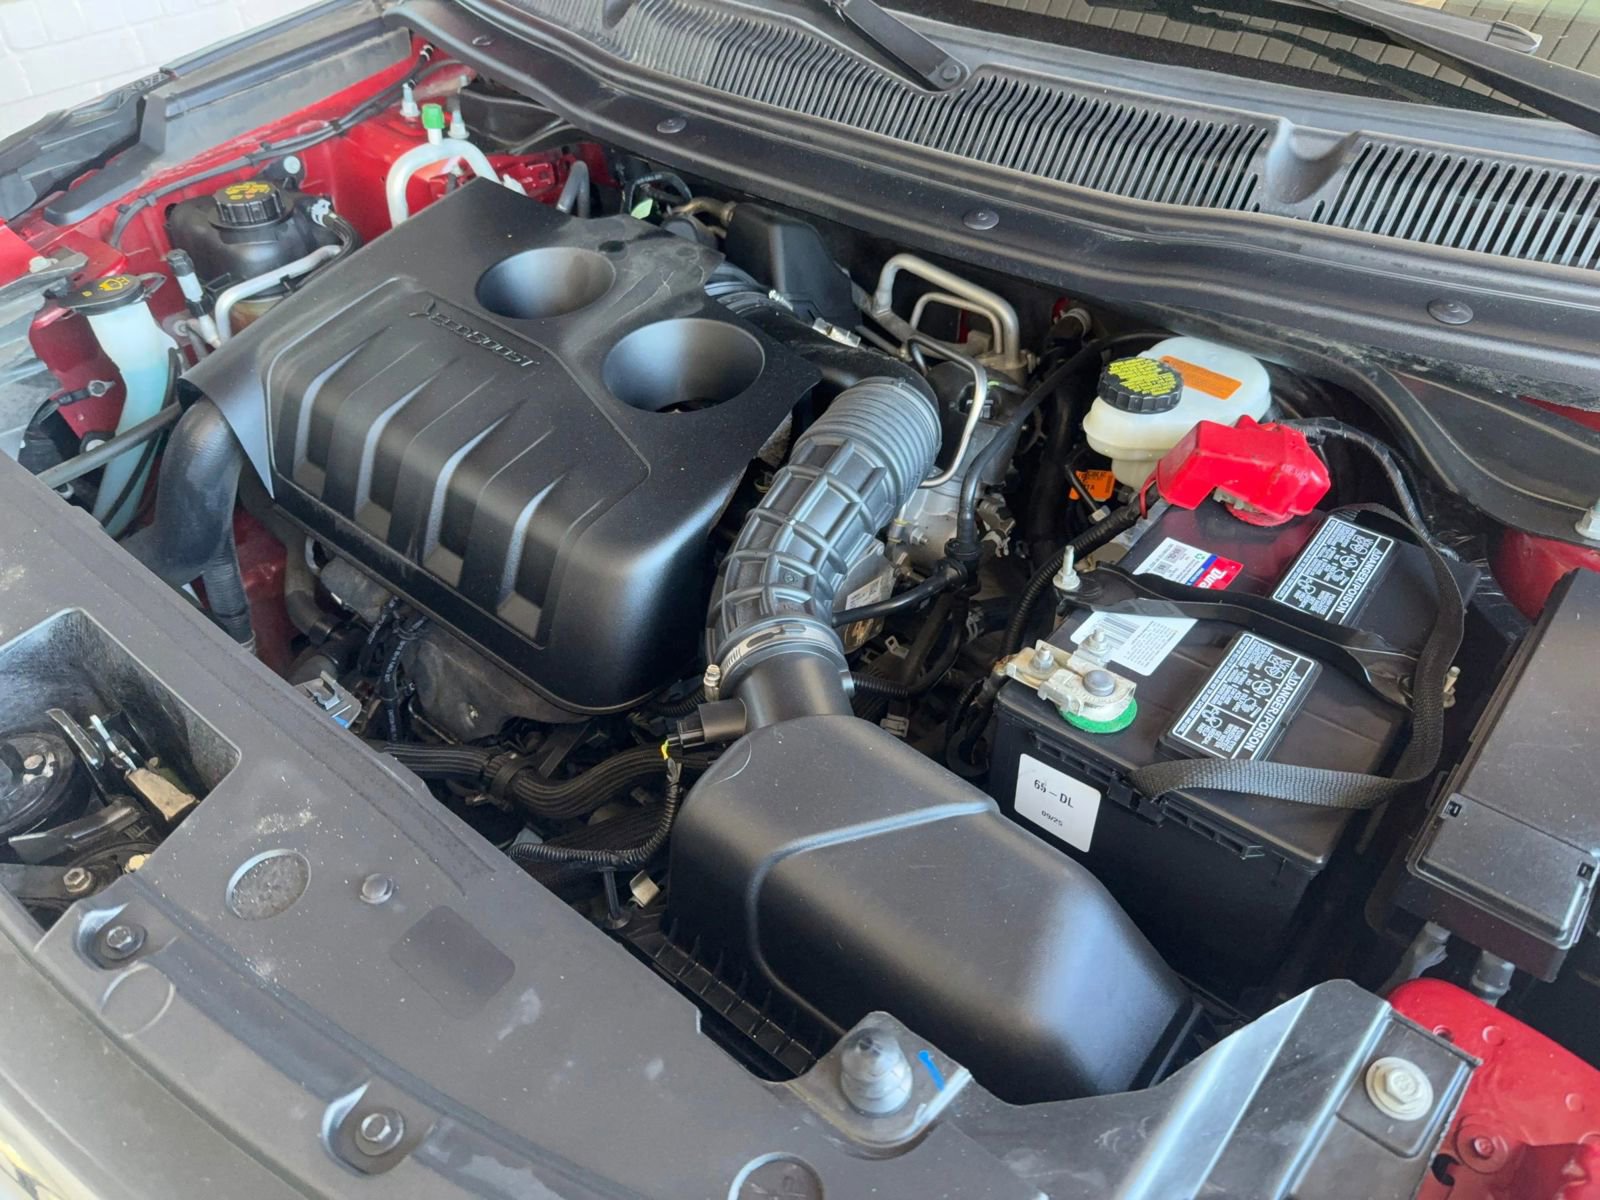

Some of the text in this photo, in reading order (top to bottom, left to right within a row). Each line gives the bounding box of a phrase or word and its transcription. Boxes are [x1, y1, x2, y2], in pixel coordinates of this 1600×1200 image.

[1335, 553, 1381, 613] DANGER/POISON
[1244, 677, 1299, 752] DANGER/POISON
[1033, 779, 1047, 793] 65
[1059, 793, 1074, 808] DL
